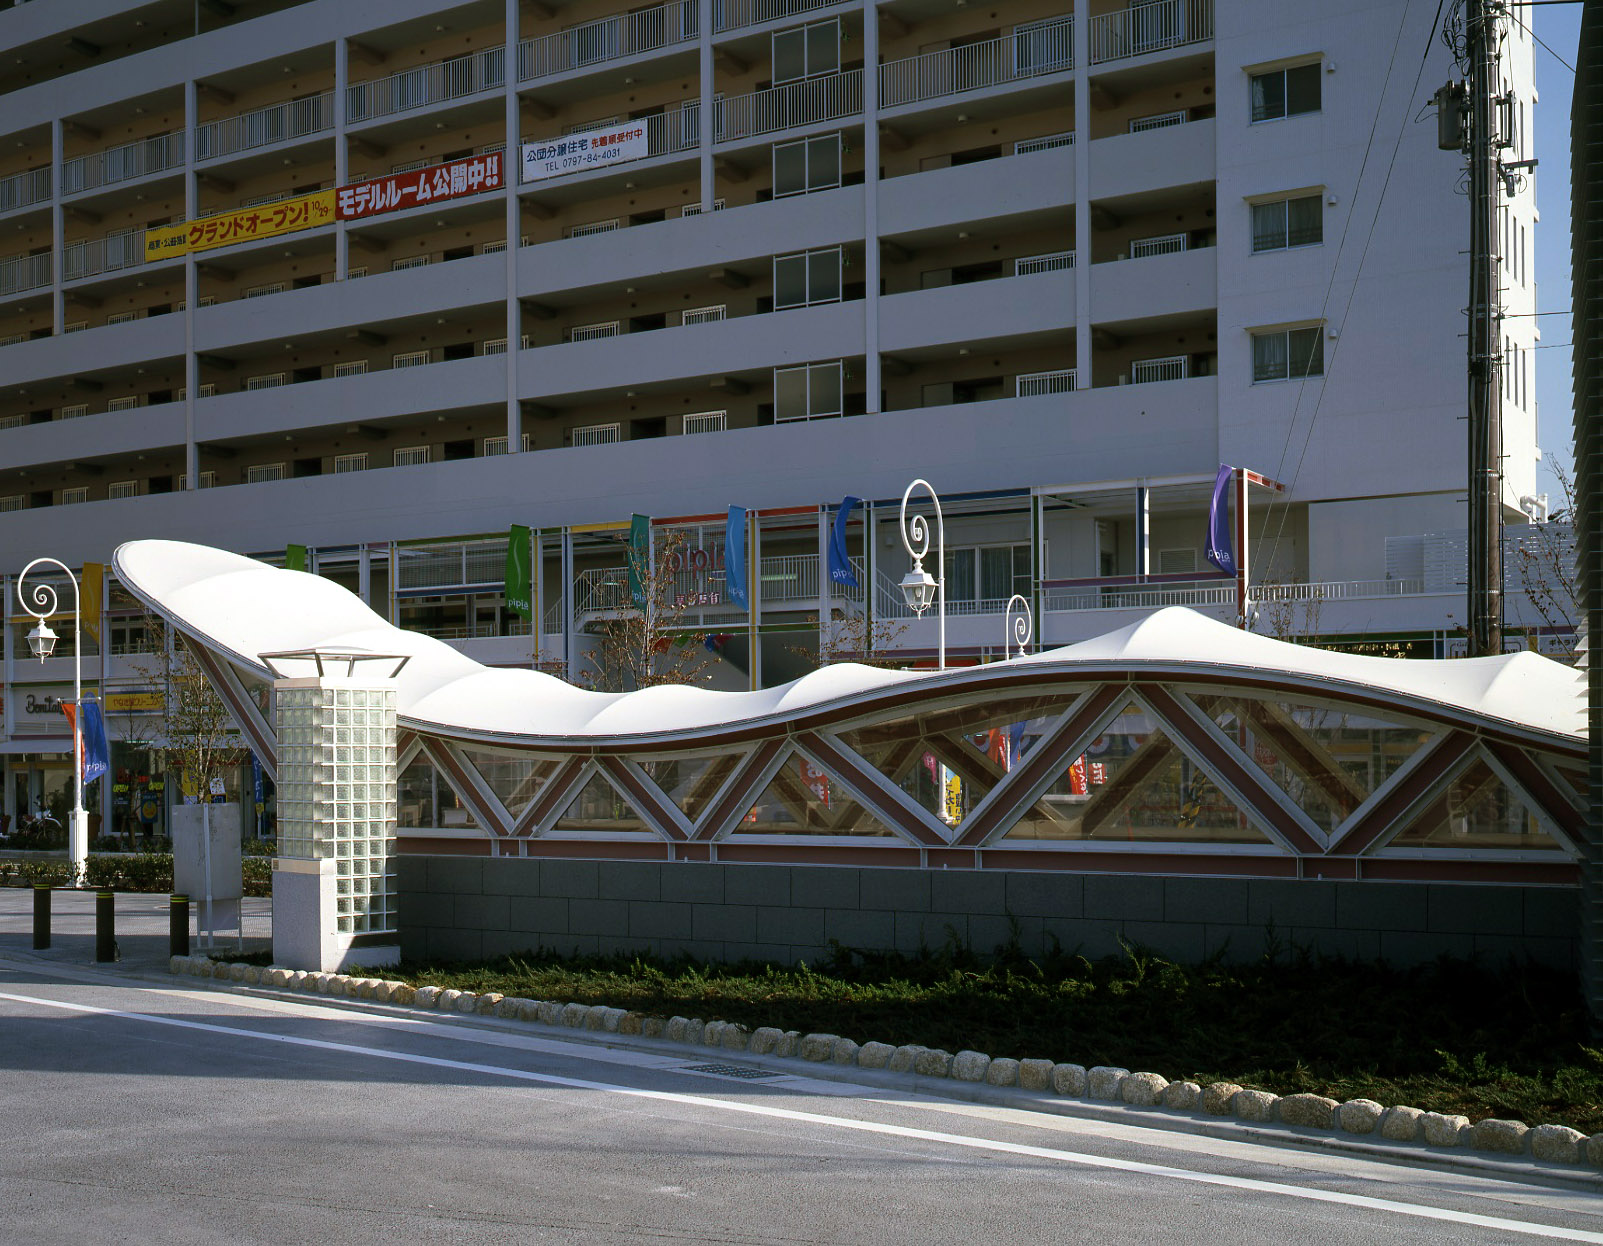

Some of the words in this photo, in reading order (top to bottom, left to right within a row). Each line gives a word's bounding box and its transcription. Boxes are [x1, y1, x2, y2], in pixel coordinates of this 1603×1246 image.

[526, 138, 588, 162] 公団分譲住宅
[591, 128, 643, 150] 先着順受付中
[545, 161, 559, 172] TEL
[562, 147, 620, 168] 0797-84-4031
[508, 597, 529, 608] pipia
